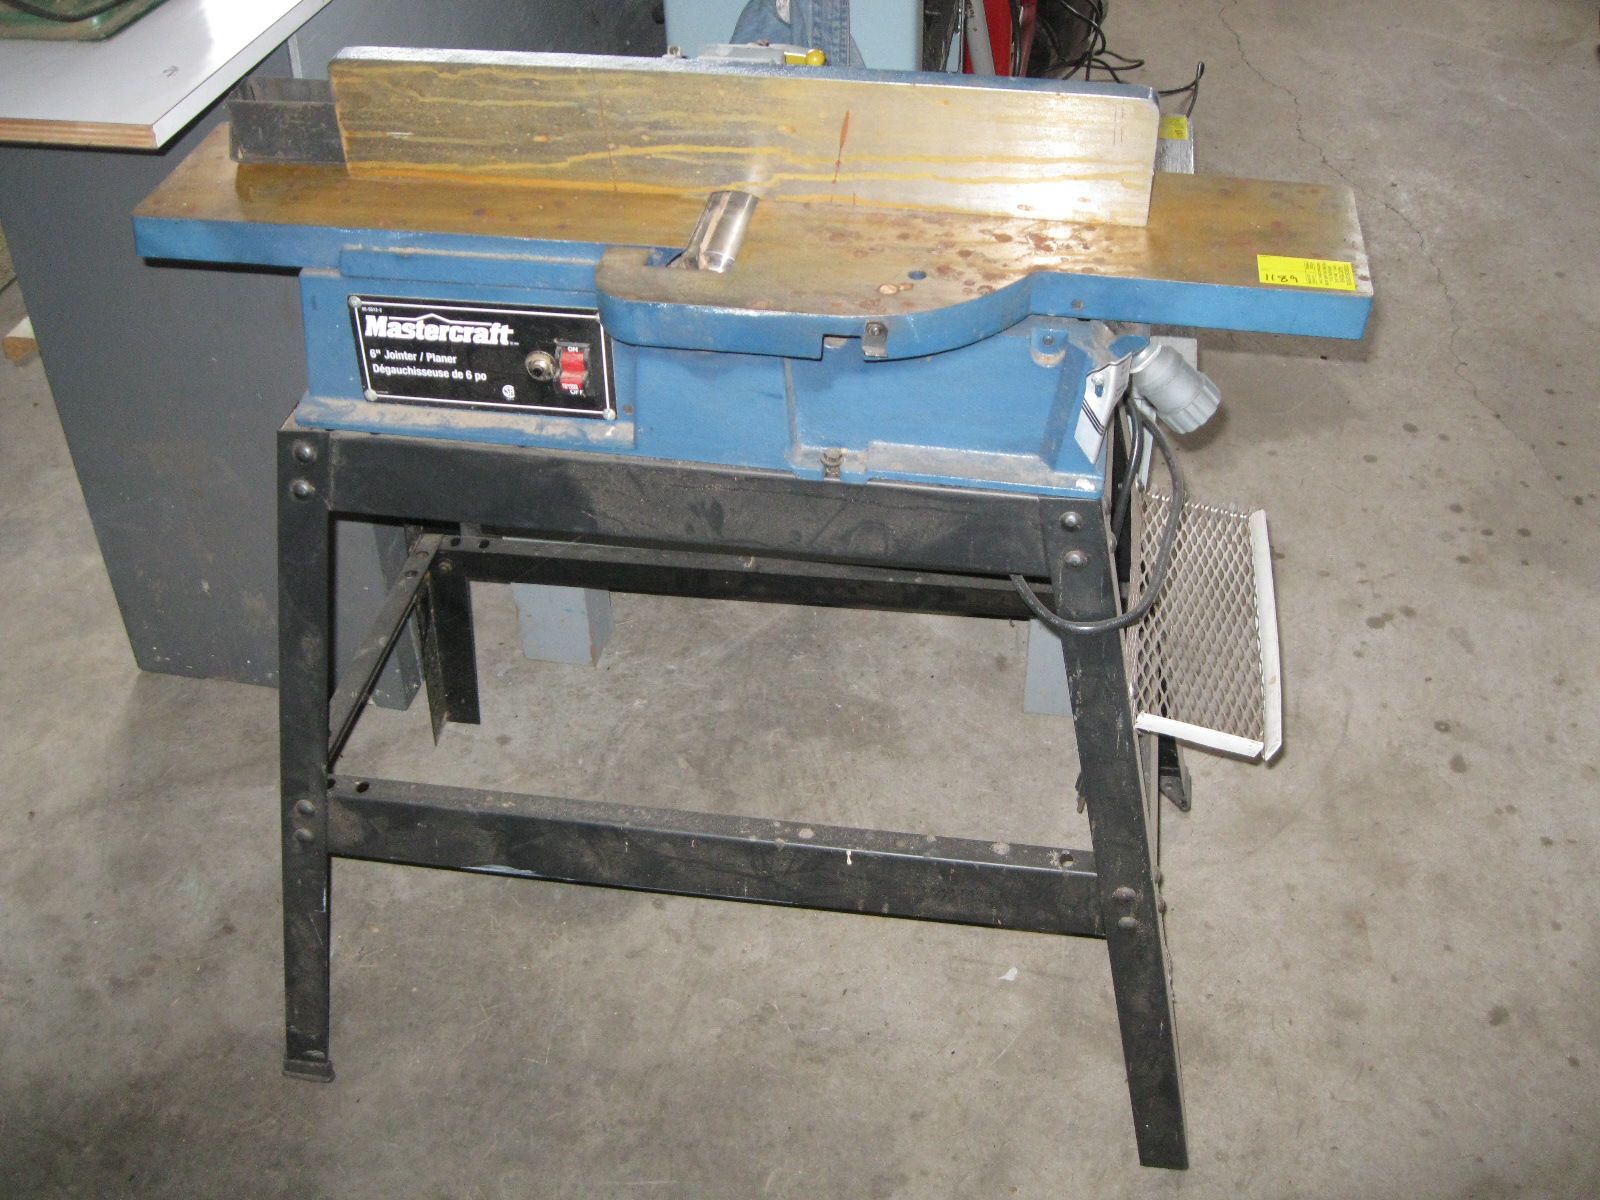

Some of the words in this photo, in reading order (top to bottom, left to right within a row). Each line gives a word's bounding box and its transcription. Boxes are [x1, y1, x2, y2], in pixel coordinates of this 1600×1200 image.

[1265, 273, 1298, 283] 1189
[364, 315, 514, 345] Mastercraft
[369, 348, 381, 358] 6"
[384, 349, 417, 361] Jointer
[419, 352, 424, 362] /
[426, 353, 457, 364] Planer
[372, 363, 450, 379] Dégauchisseuse
[451, 368, 464, 379] de
[465, 370, 472, 380] 6
[474, 372, 487, 382] po
